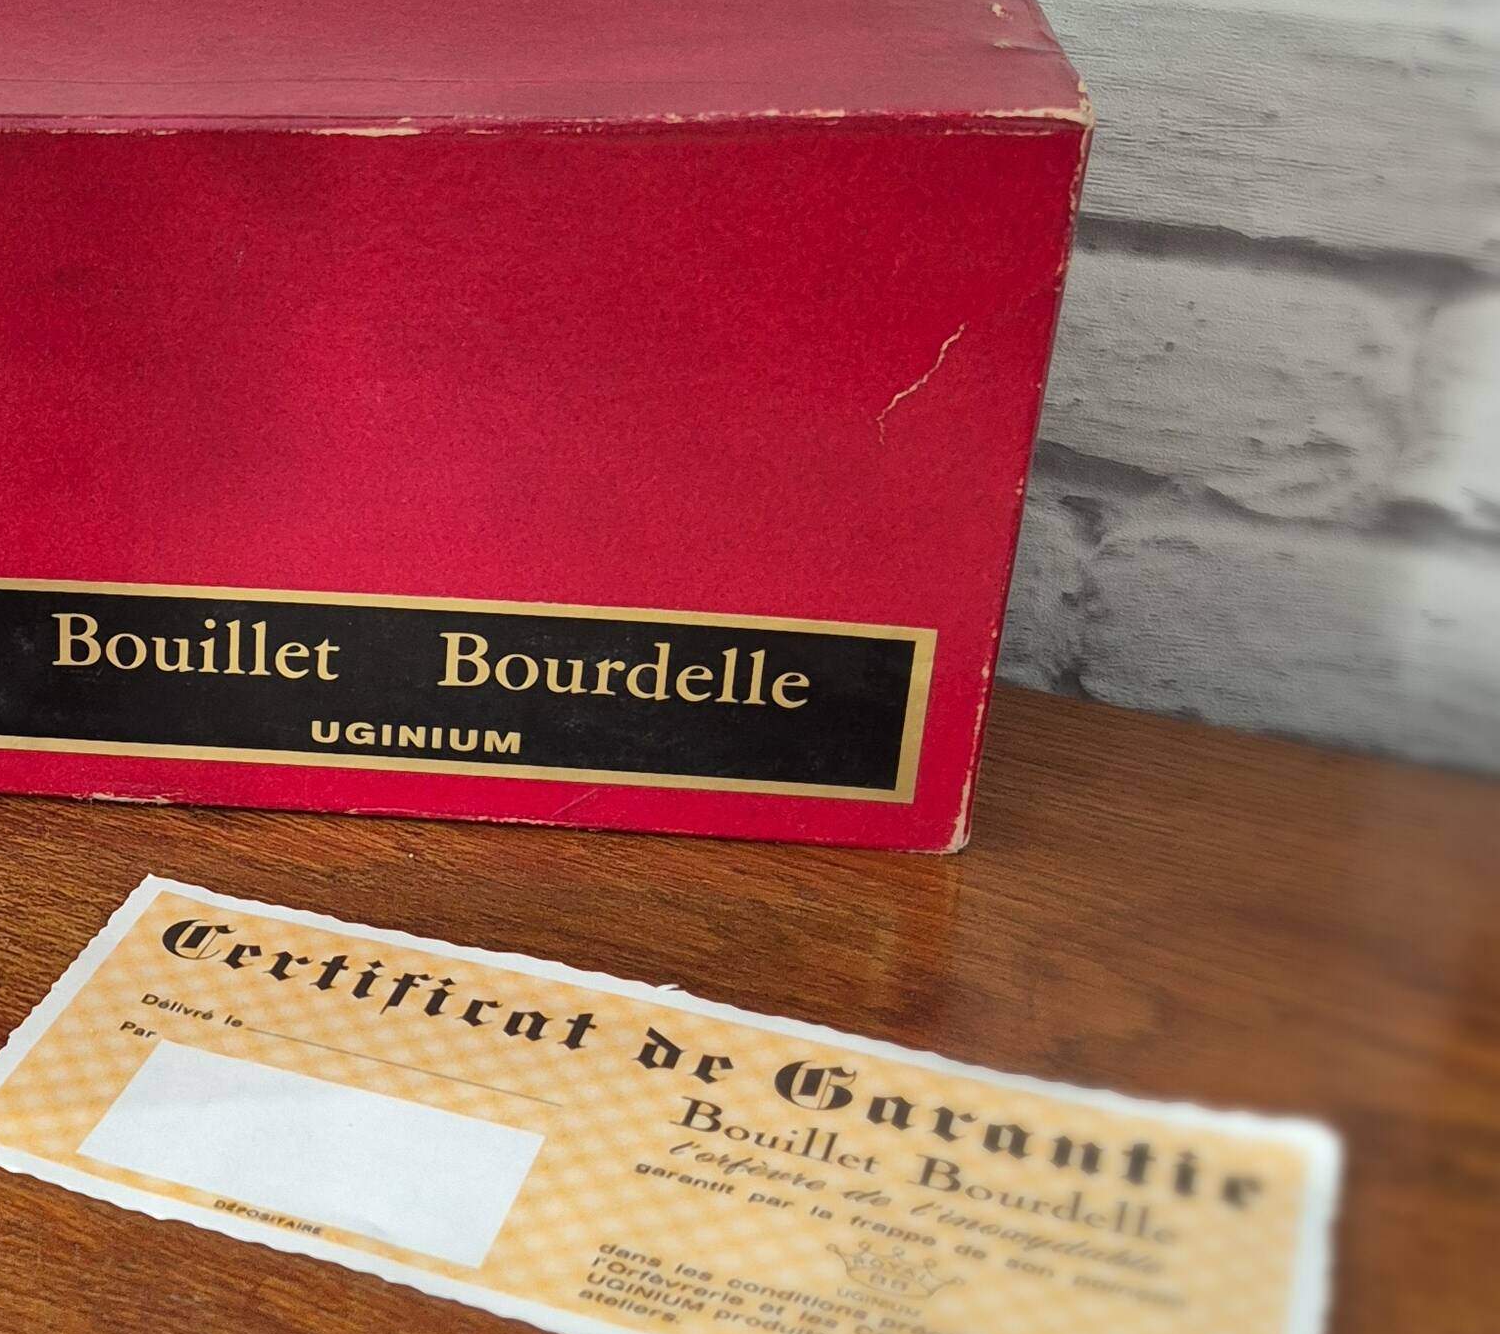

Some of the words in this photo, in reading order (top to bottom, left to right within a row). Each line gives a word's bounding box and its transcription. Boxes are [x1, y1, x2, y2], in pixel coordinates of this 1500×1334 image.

[52, 612, 339, 682] Bouillet
[437, 632, 810, 709] Bourdelle
[311, 720, 521, 754] UGINIUM
[119, 1021, 157, 1039] Par
[141, 993, 214, 1021] Délivré
[223, 1014, 244, 1028] le
[162, 918, 603, 1051] Certificat
[632, 1026, 734, 1085] de
[774, 1060, 1264, 1210] Garantie
[670, 1096, 882, 1175] Bouillet
[906, 1153, 1178, 1245] Bourdelle
[213, 1199, 324, 1236] DÉPOSITAIRE
[635, 1162, 736, 1196] garantit
[748, 1192, 795, 1211] par
[809, 1205, 834, 1220] la
[850, 1214, 938, 1248] frappe
[953, 1244, 988, 1261] de
[842, 1188, 892, 1208] de
[587, 1272, 706, 1313] UGINIUM
[599, 1243, 662, 1268] dans
[674, 1263, 714, 1282] les
[727, 1278, 868, 1320] conditions
[758, 1302, 786, 1317] et
[799, 1310, 839, 1329] les
